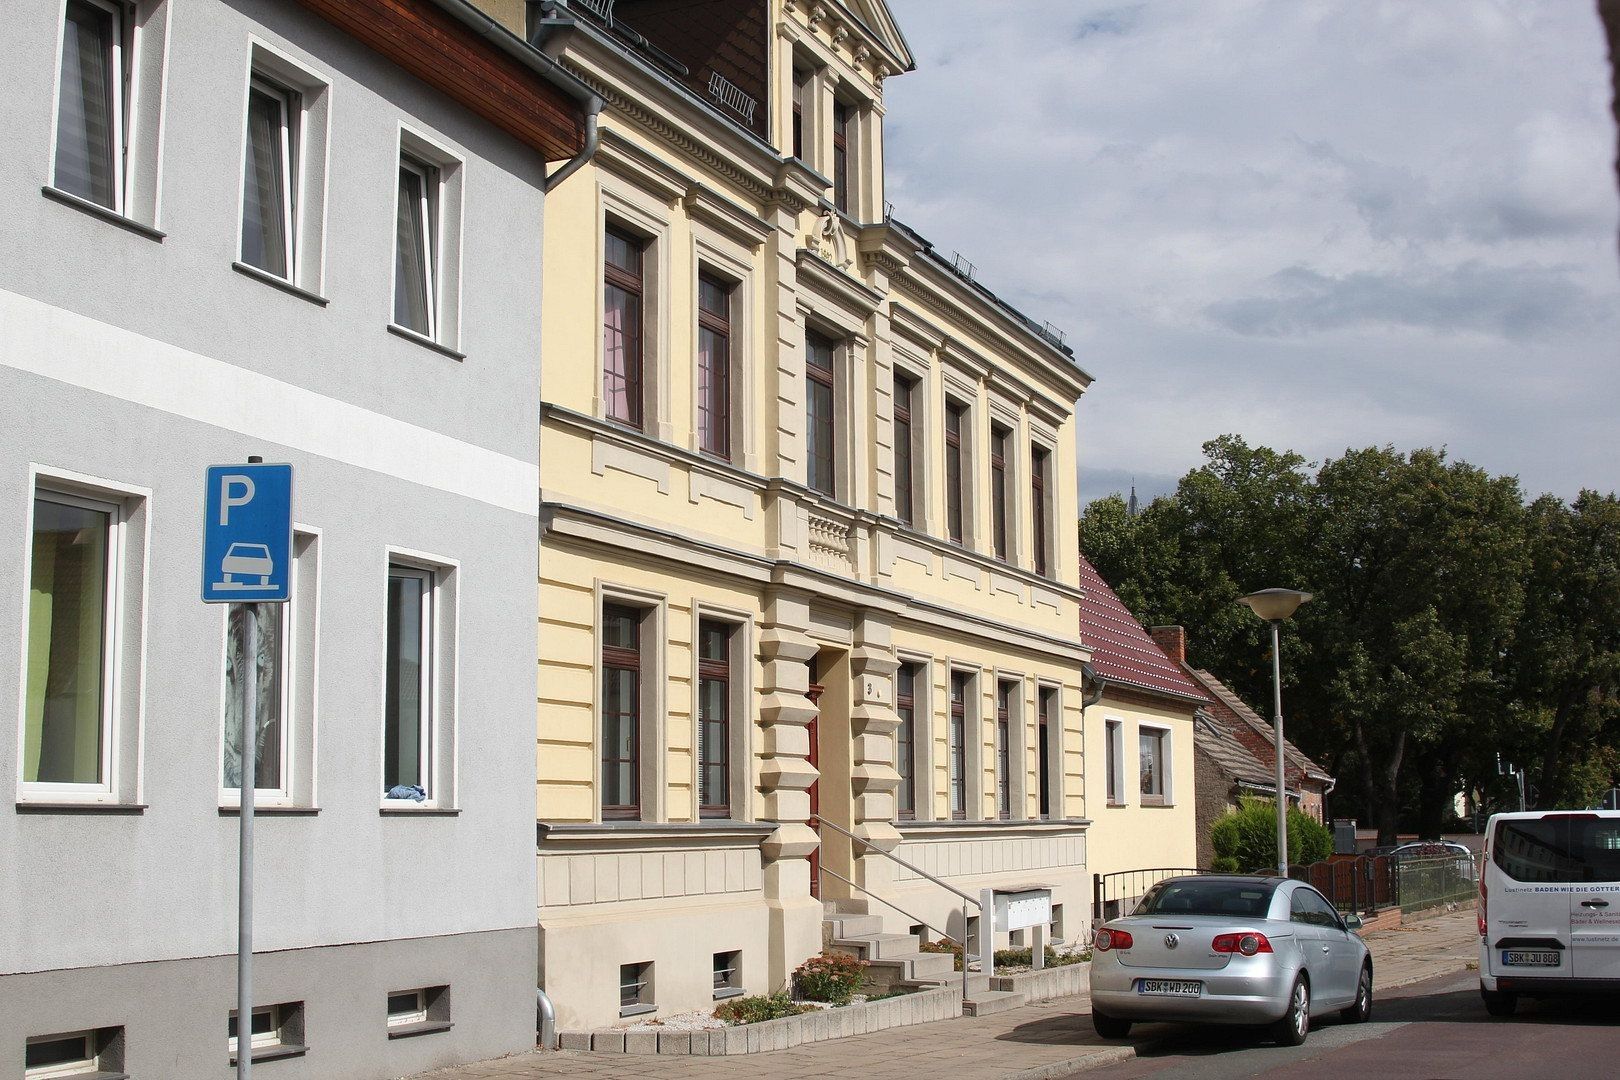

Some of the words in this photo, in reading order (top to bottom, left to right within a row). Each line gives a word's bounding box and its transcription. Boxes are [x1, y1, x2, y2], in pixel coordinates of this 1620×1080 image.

[219, 474, 256, 526] P
[867, 682, 872, 695] 3
[1508, 953, 1525, 963] SBK
[1530, 953, 1541, 963] JU
[1542, 953, 1558, 964] 808
[1145, 981, 1163, 992] SBK
[1169, 981, 1182, 993] WD
[1182, 982, 1200, 994] 200
